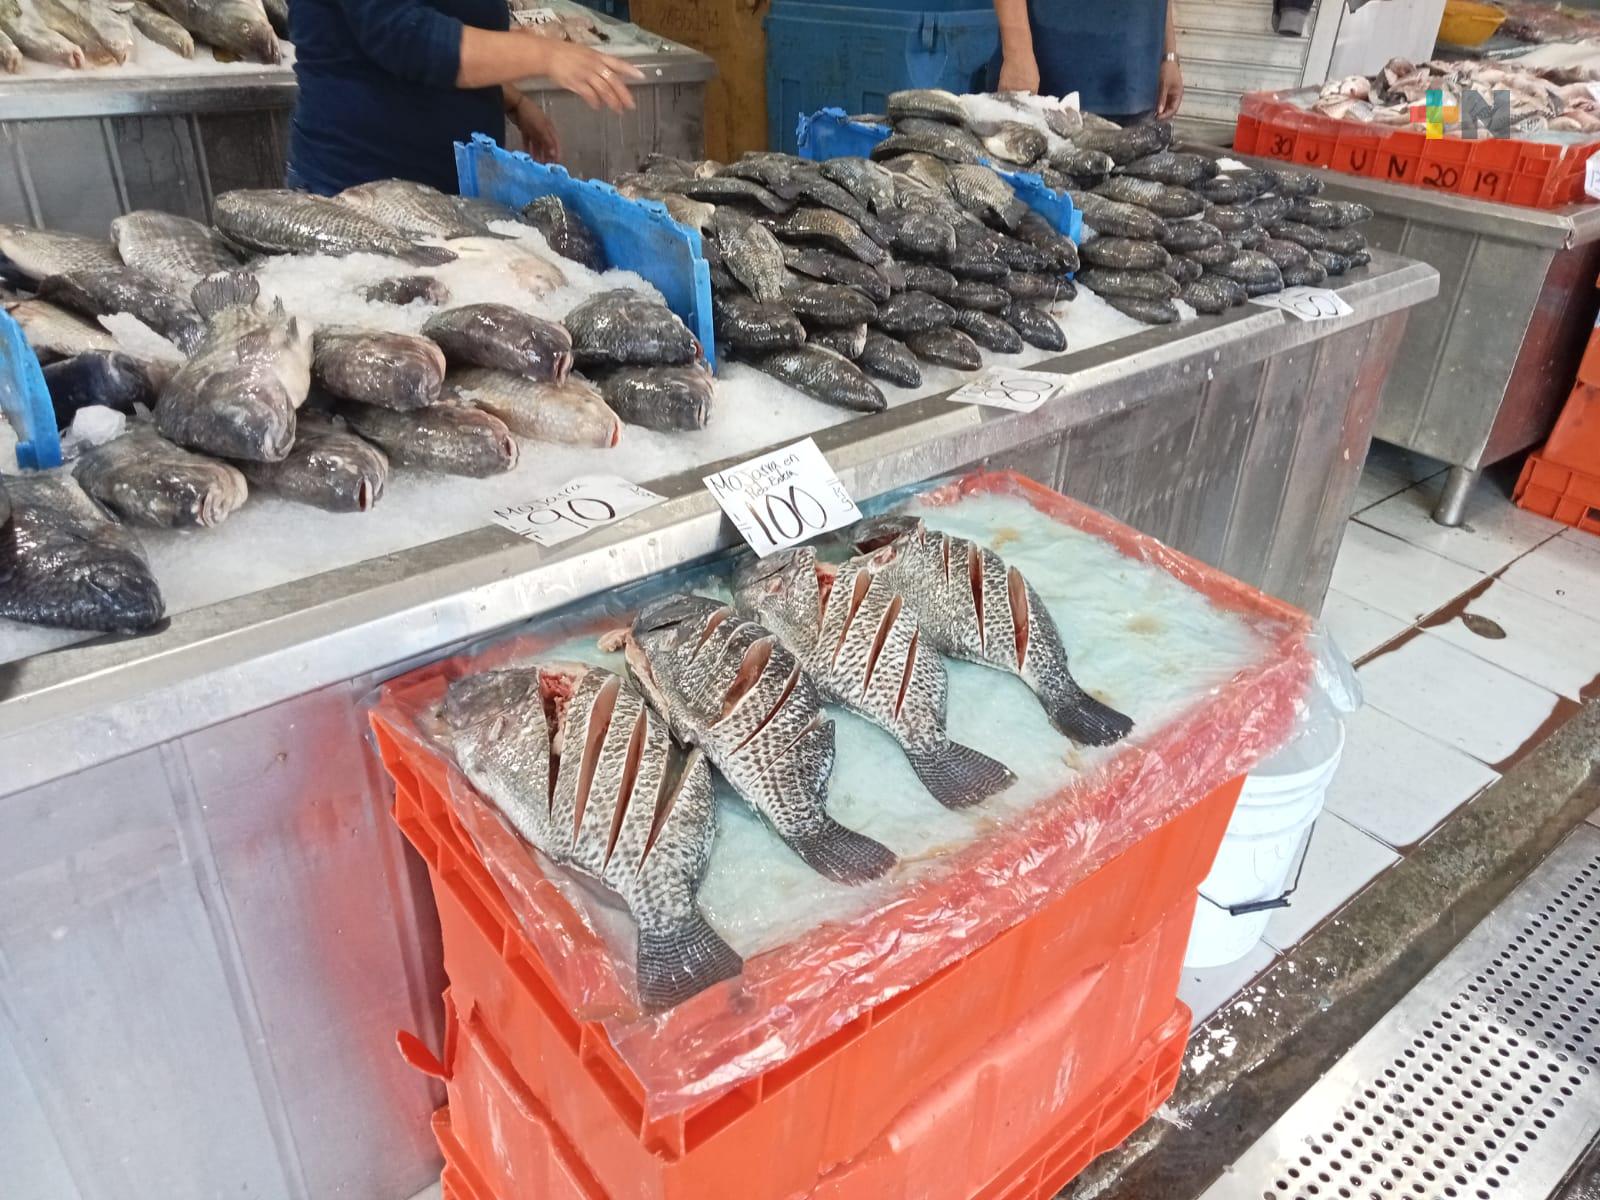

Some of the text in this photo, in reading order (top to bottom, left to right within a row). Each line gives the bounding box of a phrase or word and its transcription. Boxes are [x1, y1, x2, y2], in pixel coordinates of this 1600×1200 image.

[1269, 133, 1294, 157] 30
[527, 498, 616, 530] 90
[745, 484, 828, 546] 100
